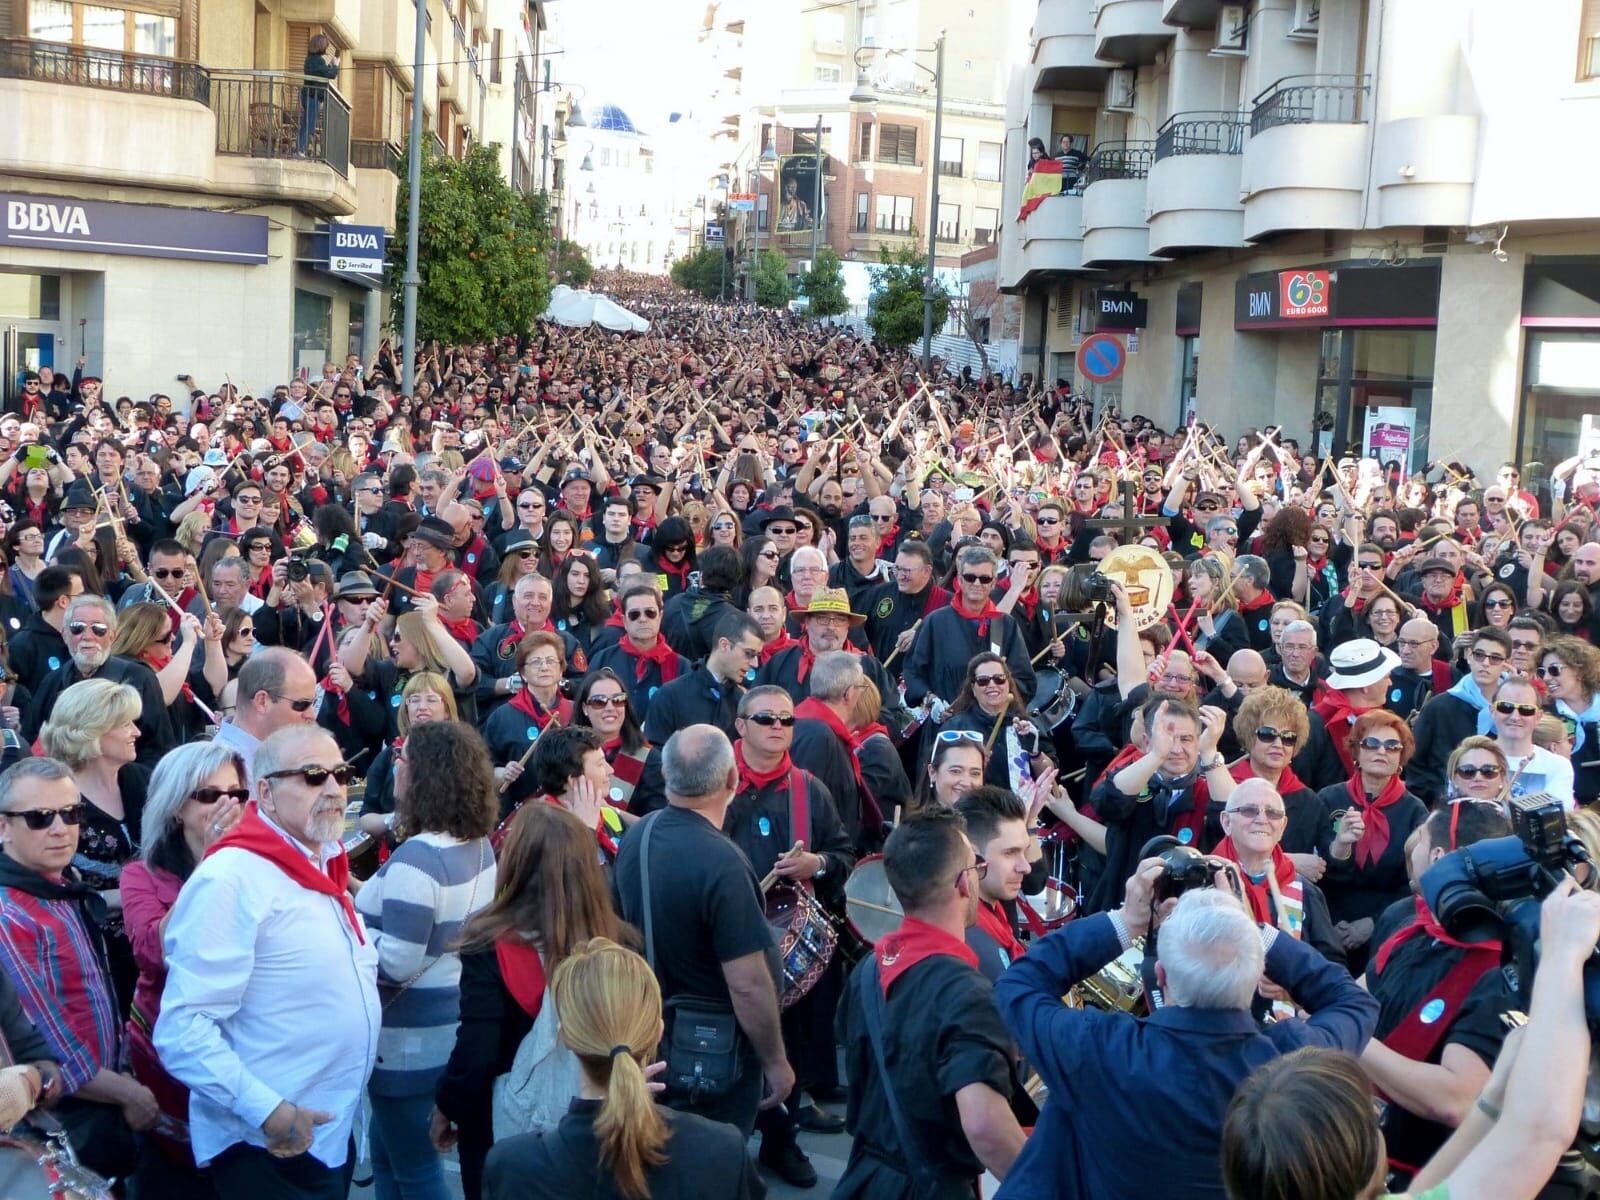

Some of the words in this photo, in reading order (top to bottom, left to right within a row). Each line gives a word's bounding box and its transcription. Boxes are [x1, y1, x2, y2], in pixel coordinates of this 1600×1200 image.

[7, 200, 91, 236] BBVA
[335, 232, 379, 250] BBVA
[1101, 299, 1134, 313] BMN
[1249, 290, 1272, 317] BMN
[1286, 307, 1306, 315] EURO
[1307, 306, 1328, 314] 6000
